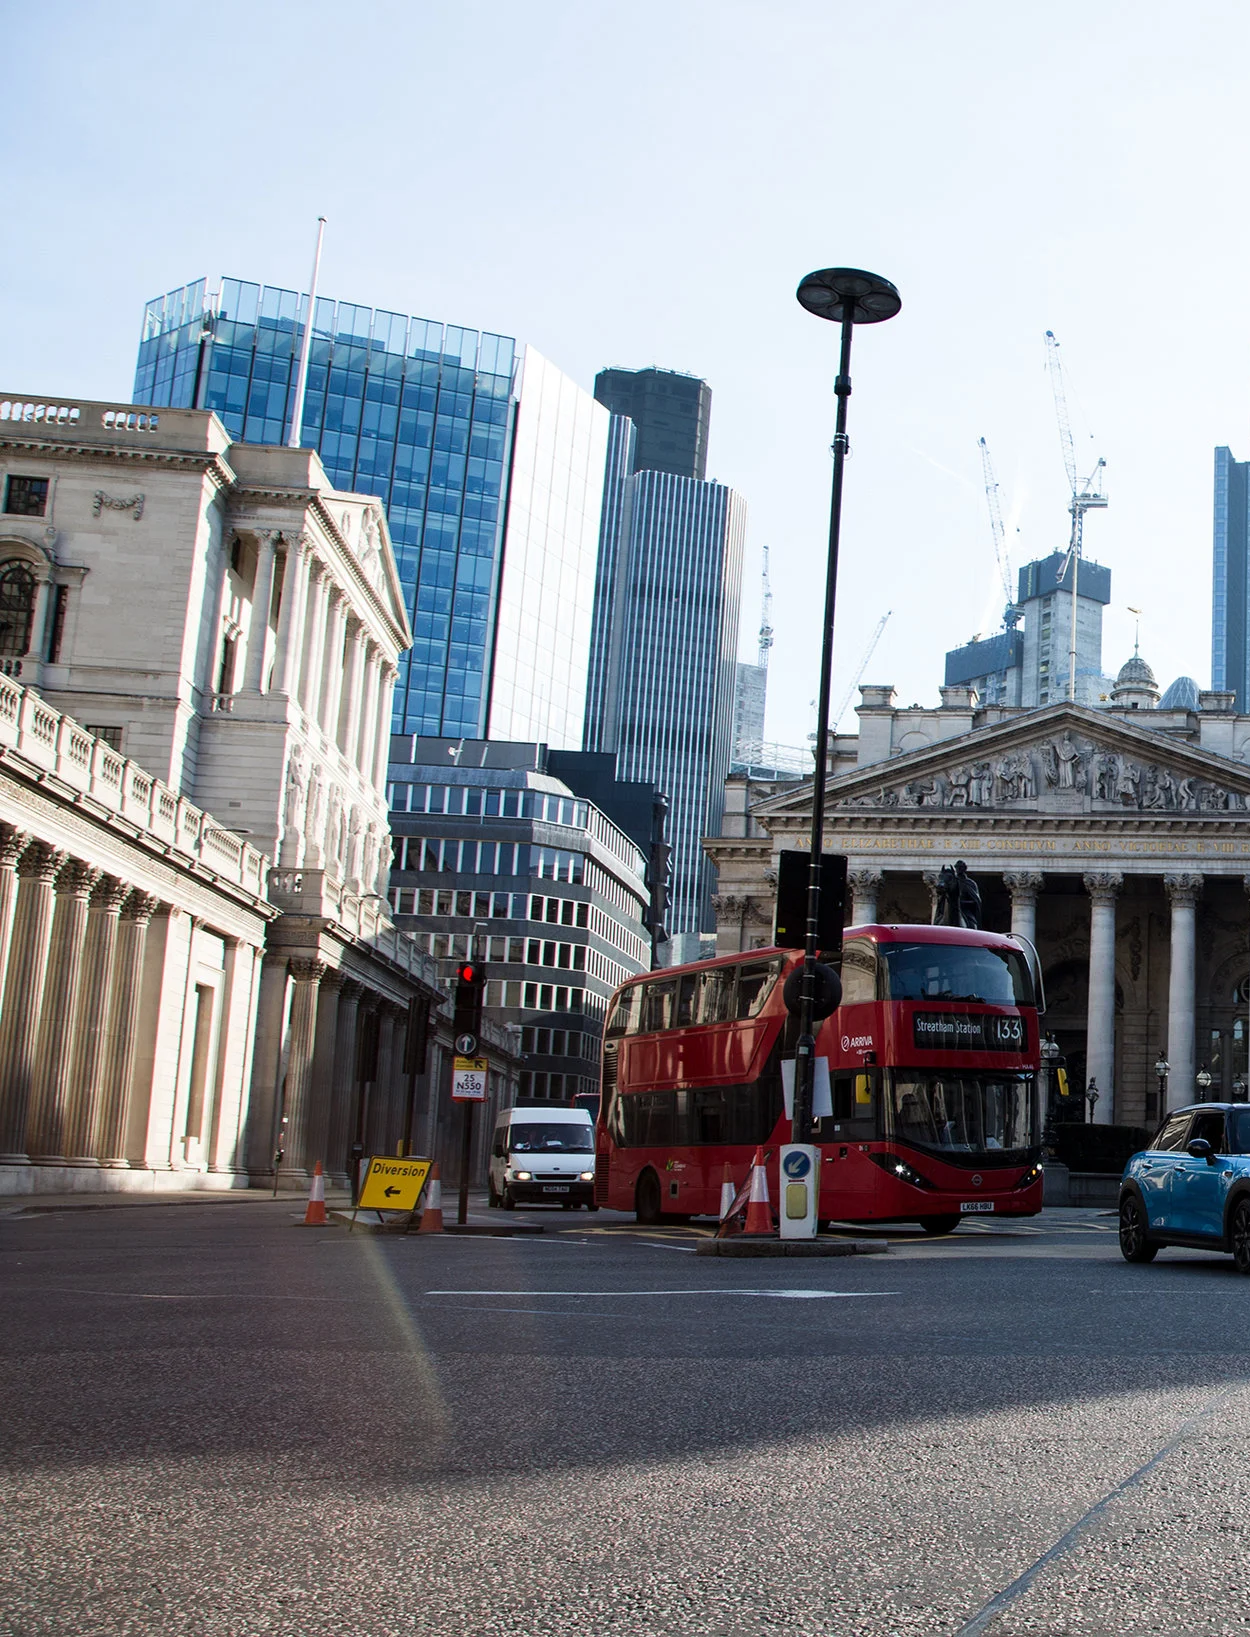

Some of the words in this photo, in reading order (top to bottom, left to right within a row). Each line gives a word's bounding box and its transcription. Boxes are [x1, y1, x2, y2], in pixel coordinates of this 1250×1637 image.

[793, 837, 833, 848] ANO
[1072, 840, 1111, 851] ANNO
[917, 1018, 954, 1033] Streatham
[955, 1020, 981, 1034] Station
[997, 1019, 1021, 1039] 133
[850, 1035, 873, 1048] ARRIVA
[463, 1074, 475, 1082] 25
[456, 1081, 482, 1090] N550
[372, 1162, 425, 1177] Diversion
[962, 1202, 978, 1211] LK66
